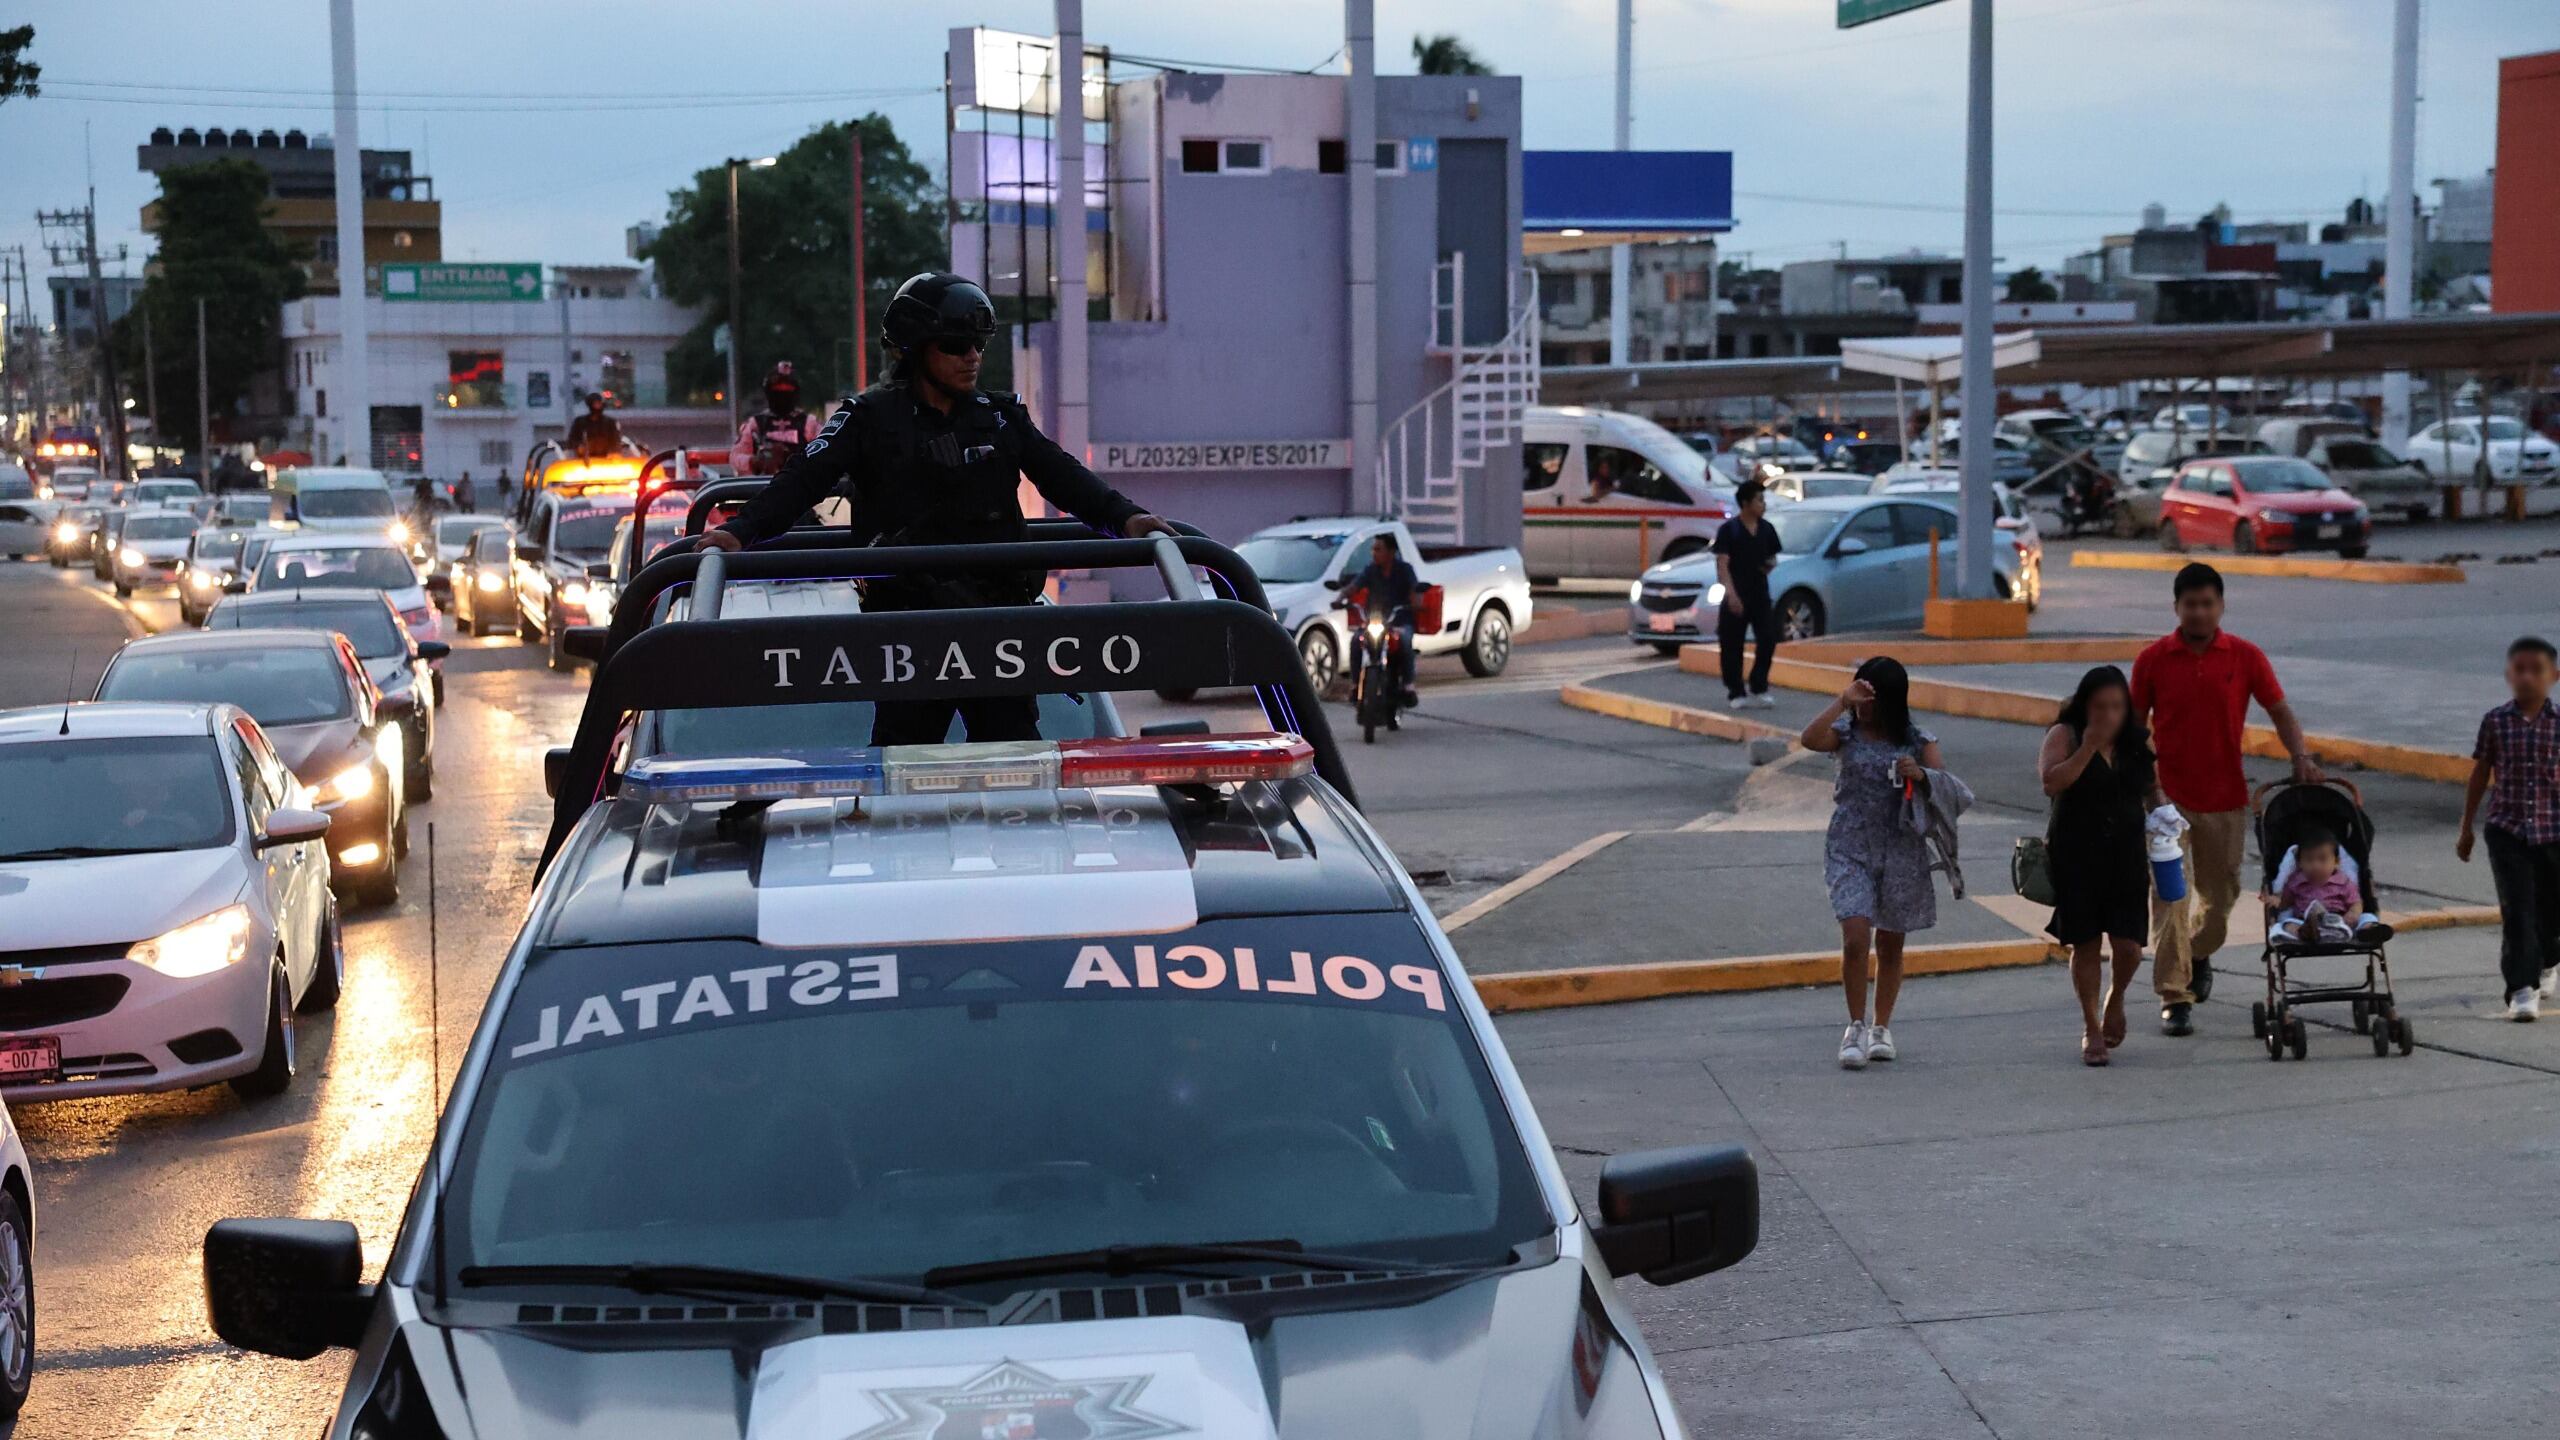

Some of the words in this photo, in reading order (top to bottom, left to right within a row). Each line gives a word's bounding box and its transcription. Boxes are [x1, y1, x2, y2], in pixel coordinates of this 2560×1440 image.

[420, 268, 509, 282] ENTRADA
[1107, 444, 1331, 468] PL/20329/EXP/ES/2017
[763, 636, 1141, 688] TABASCO
[0, 1049, 57, 1070] -007-B
